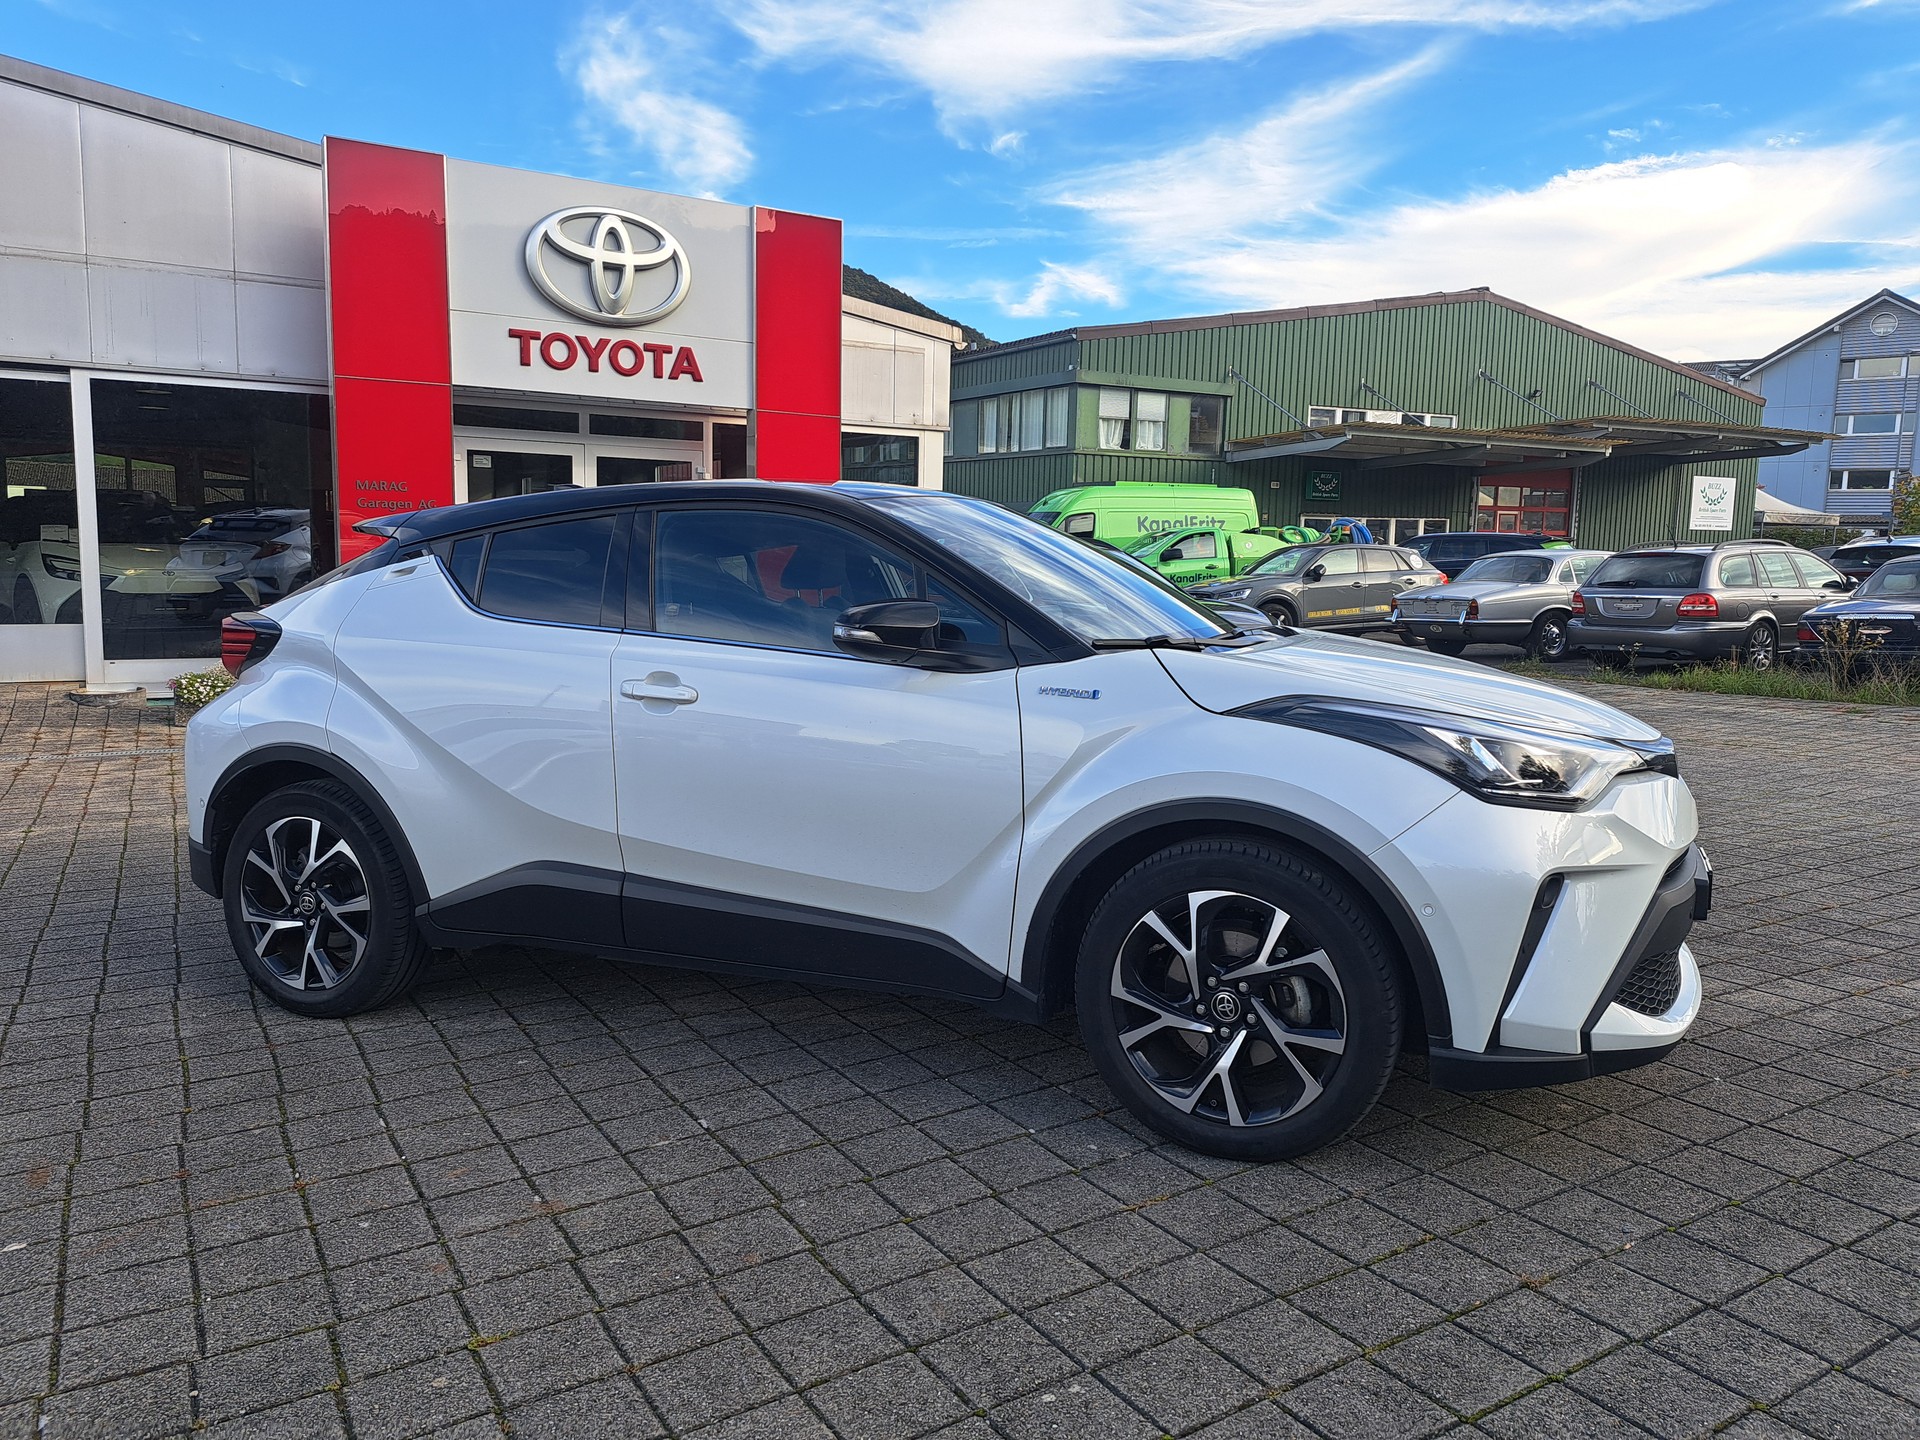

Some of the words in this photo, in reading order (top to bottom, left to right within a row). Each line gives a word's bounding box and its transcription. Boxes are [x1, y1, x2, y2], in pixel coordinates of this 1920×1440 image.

[508, 328, 704, 382] TOYOTA
[356, 480, 408, 492] MARAG
[1708, 482, 1722, 490] BUZZ
[357, 497, 413, 512] Garagen
[418, 499, 437, 509] AG
[1137, 514, 1226, 533] KanalFritz
